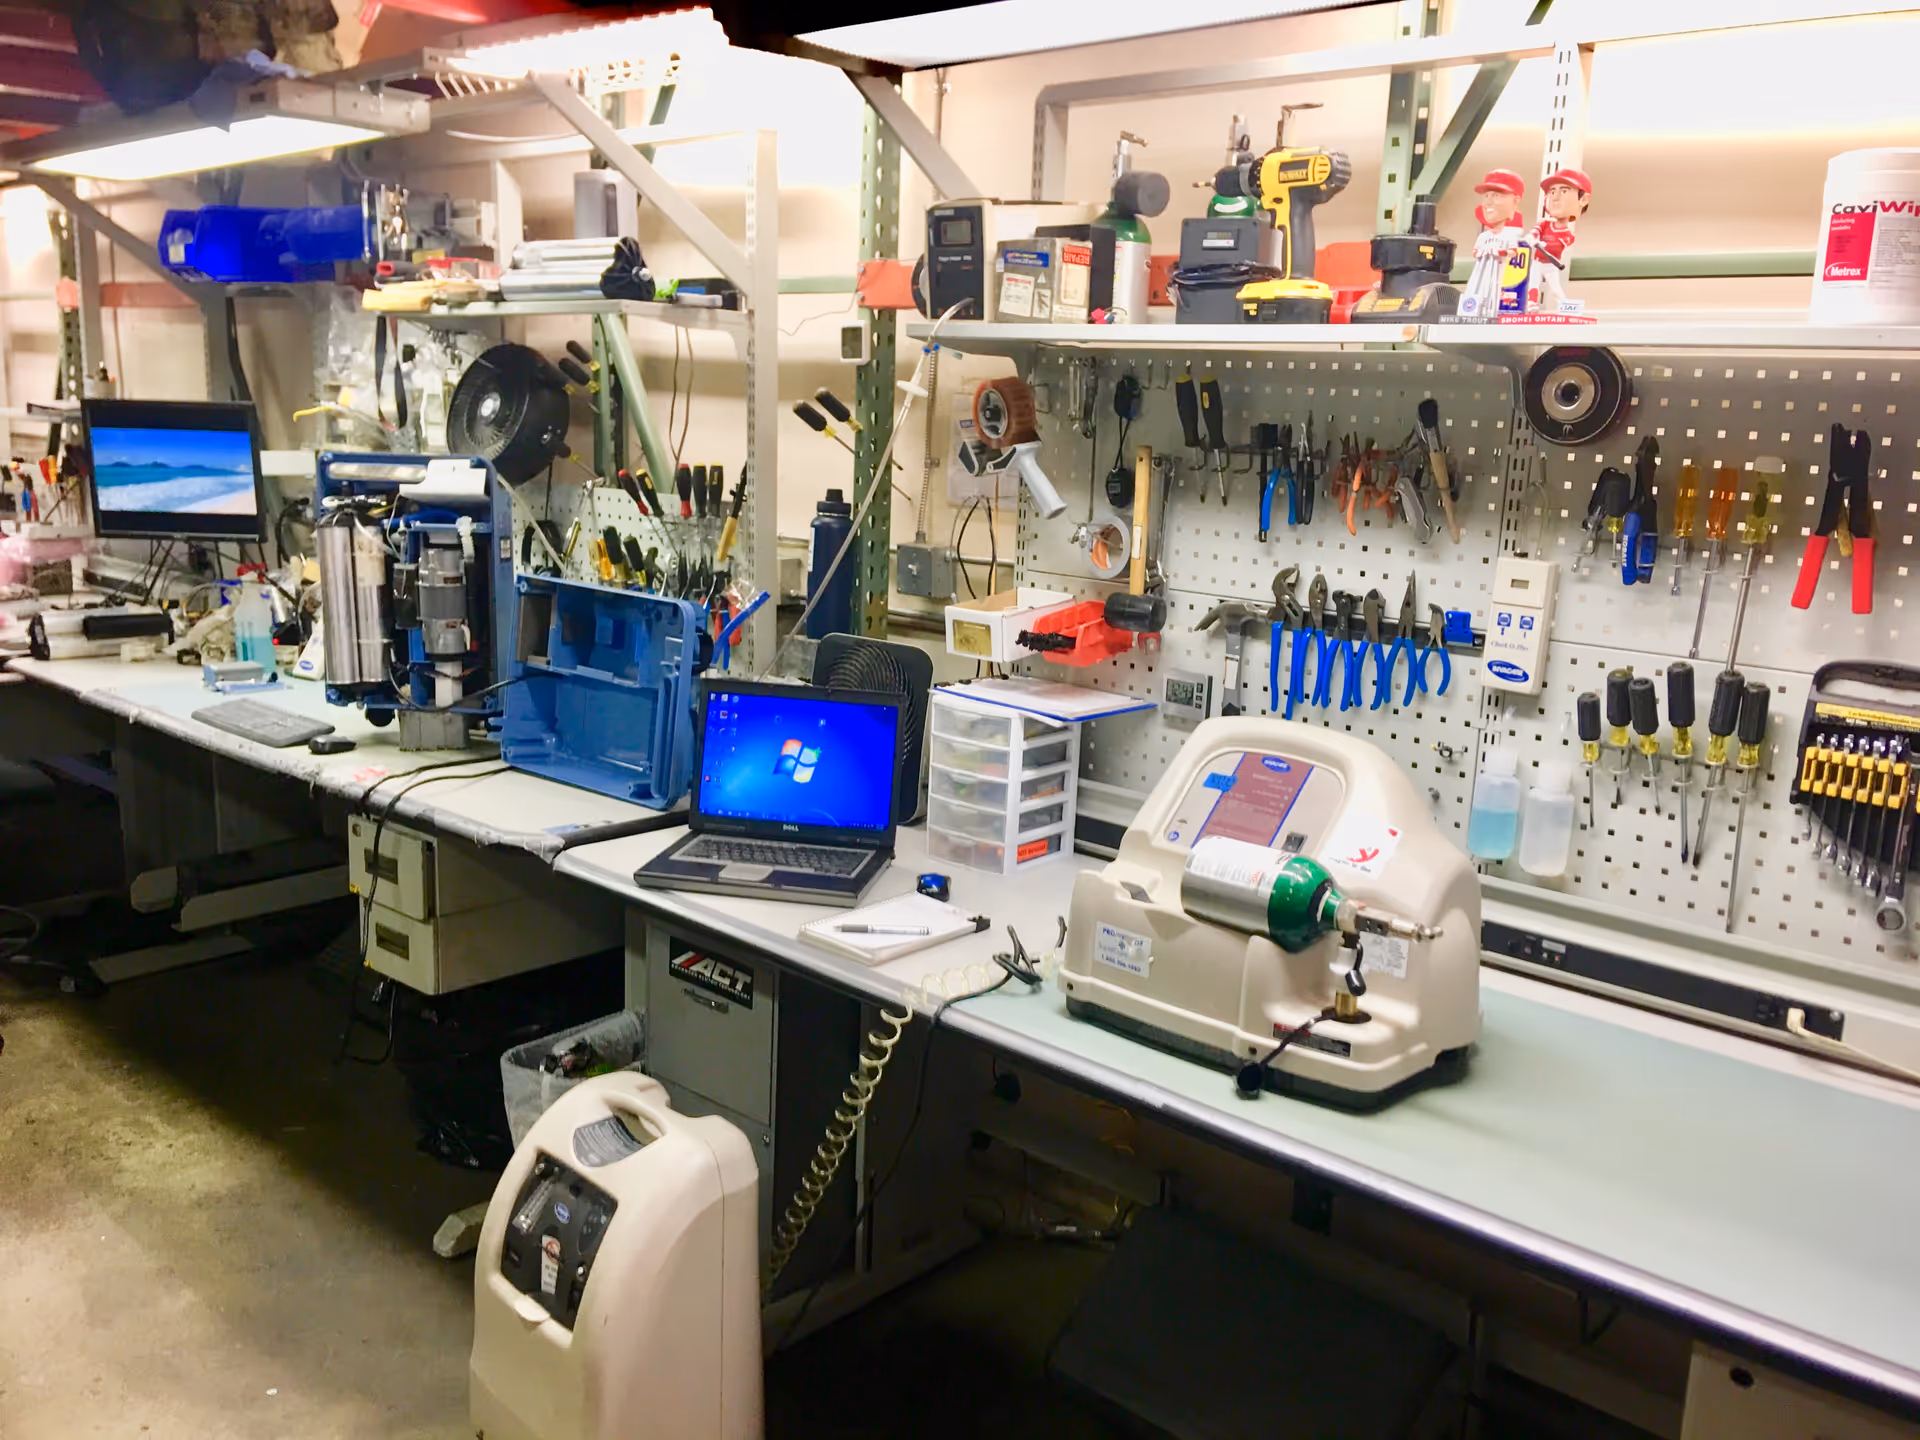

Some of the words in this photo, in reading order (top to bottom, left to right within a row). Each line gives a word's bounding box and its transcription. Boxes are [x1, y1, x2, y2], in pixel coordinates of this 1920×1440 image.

[1063, 252, 1090, 265] REPAIR
[1508, 252, 1527, 269] 40
[1830, 266, 1862, 277] Metrex
[1440, 316, 1460, 324] MIKE
[1461, 316, 1489, 325] TROUT
[1501, 316, 1532, 324] SHOHEI
[1534, 315, 1566, 324] OHTANI
[1621, 534, 1629, 568] KOBALT
[782, 823, 800, 832] DELL
